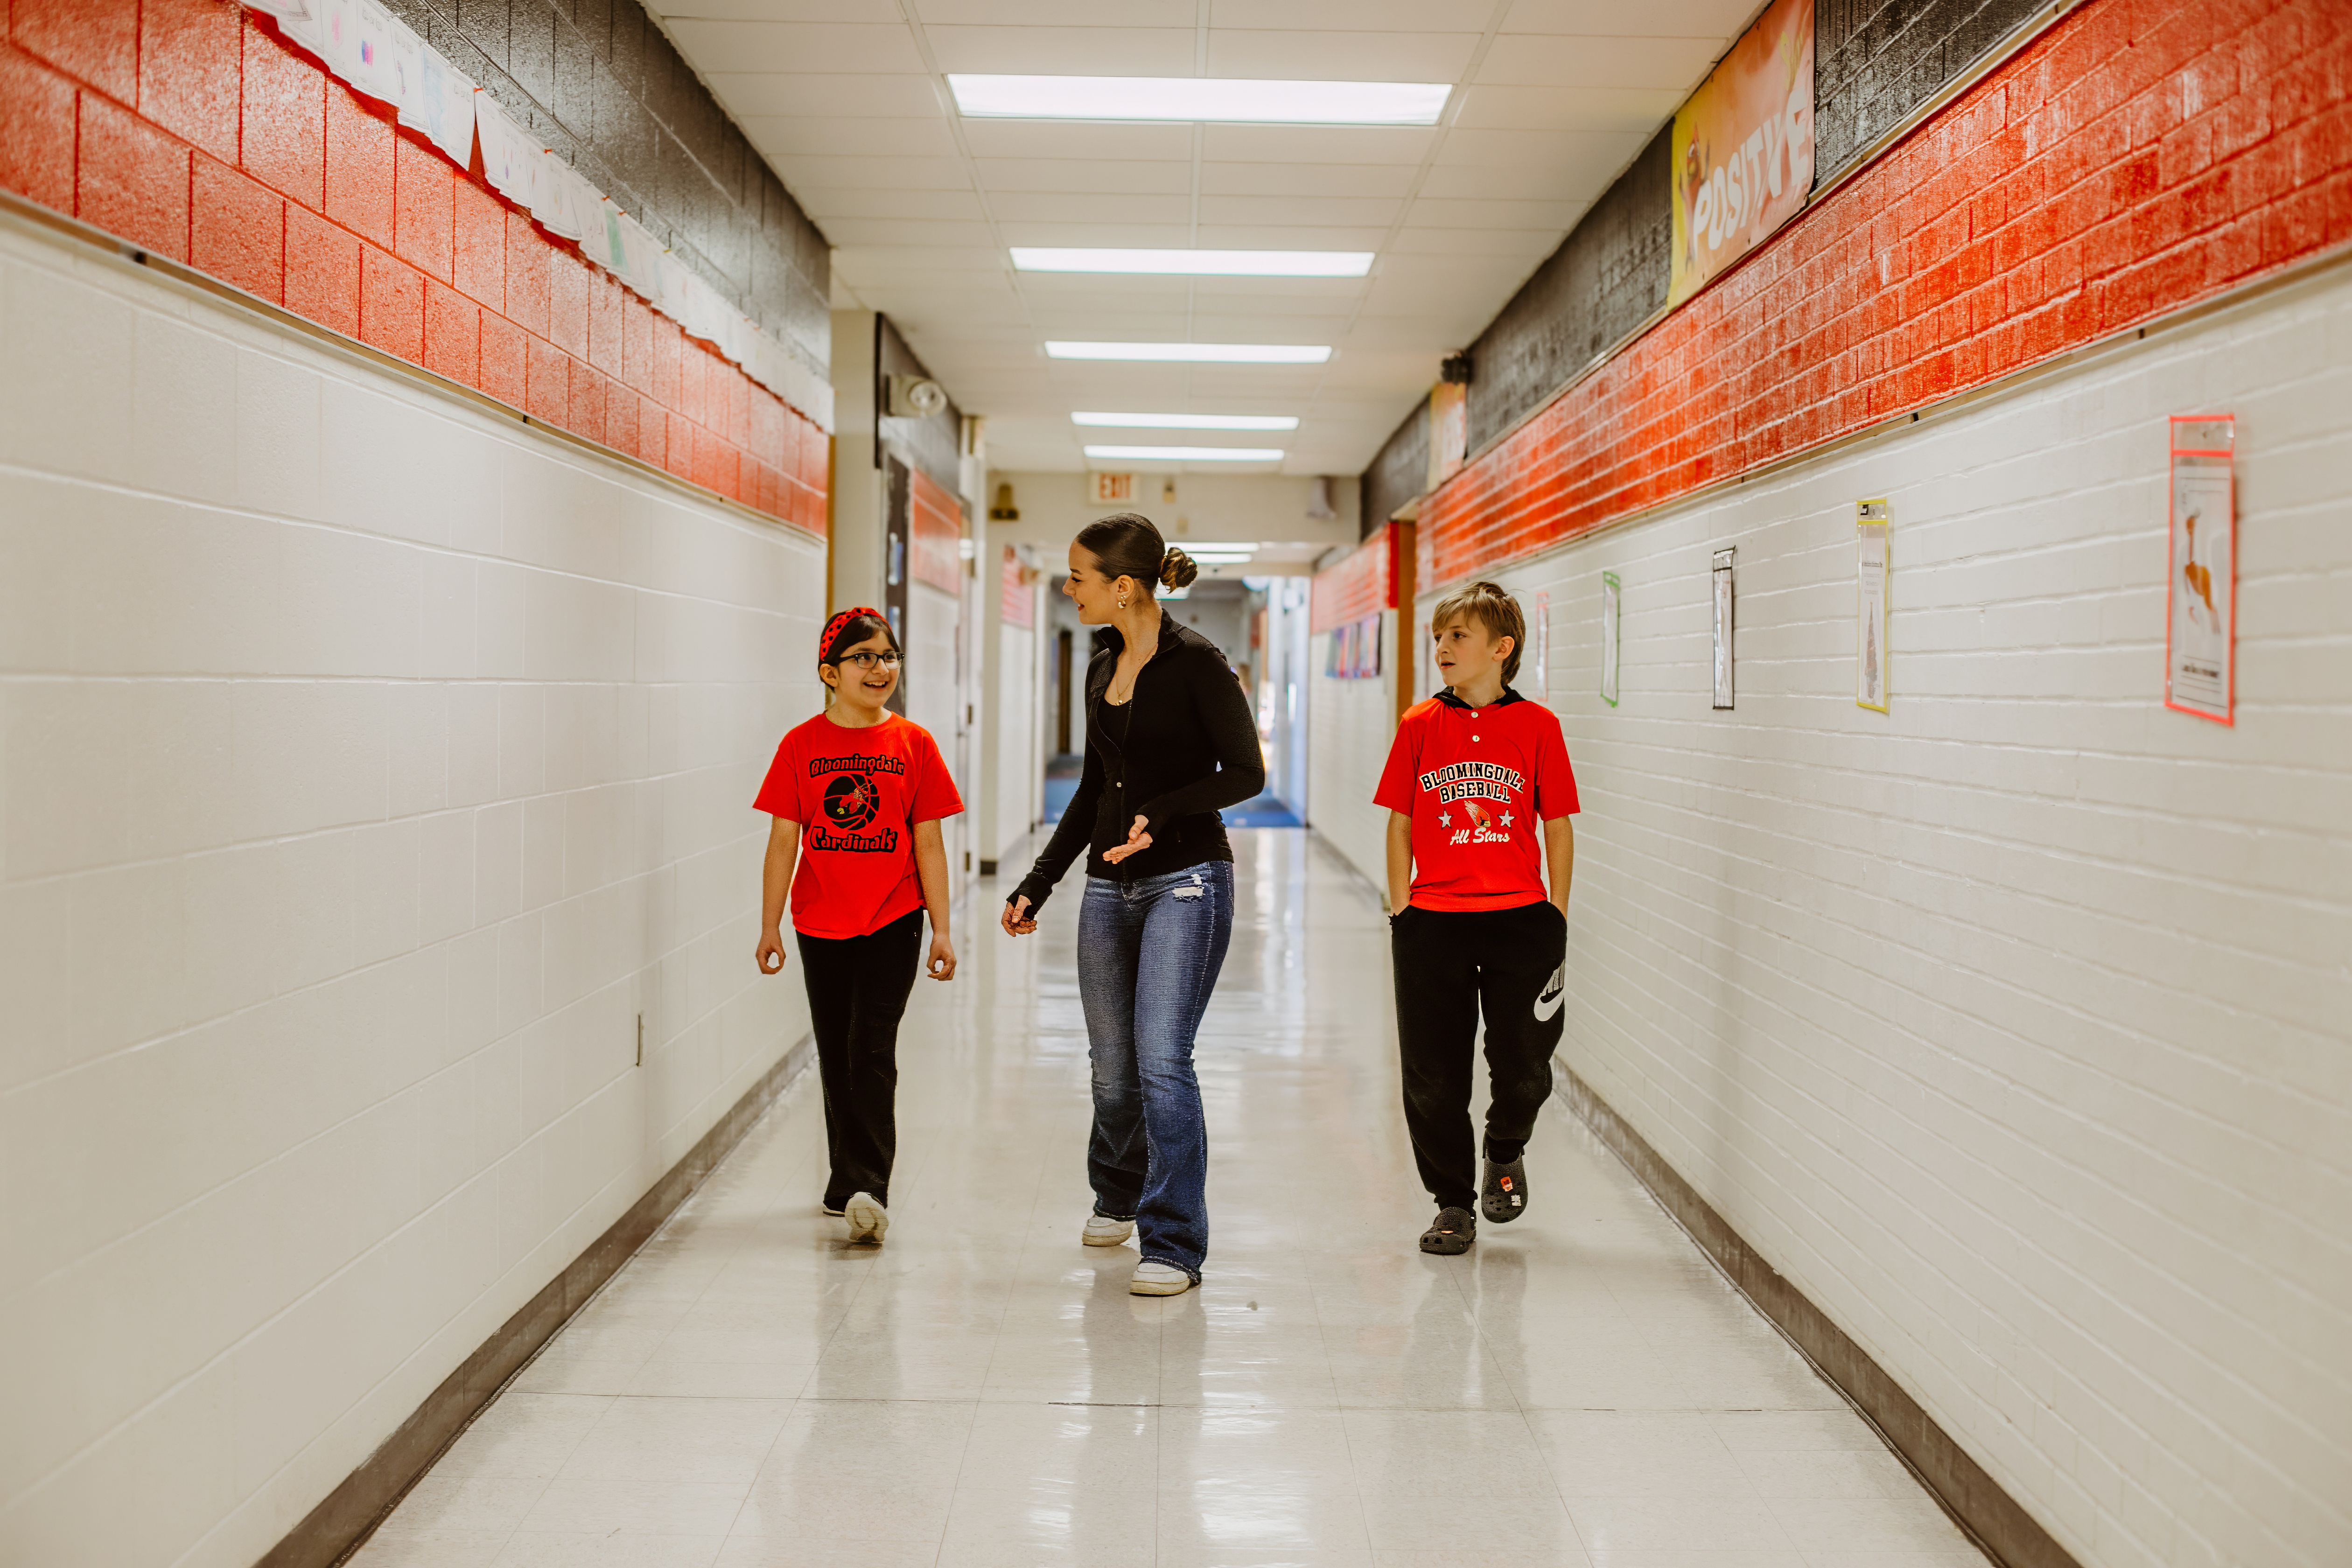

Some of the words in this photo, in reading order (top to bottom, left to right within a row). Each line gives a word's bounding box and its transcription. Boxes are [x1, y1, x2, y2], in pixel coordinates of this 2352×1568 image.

[1693, 87, 1808, 259] POSITIVE
[1099, 473, 1131, 498] EXIT
[1439, 780, 1511, 804] BASEBALL
[810, 826, 898, 853] Cardinals
[1449, 829, 1470, 845] All
[1473, 827, 1510, 843] Stars
